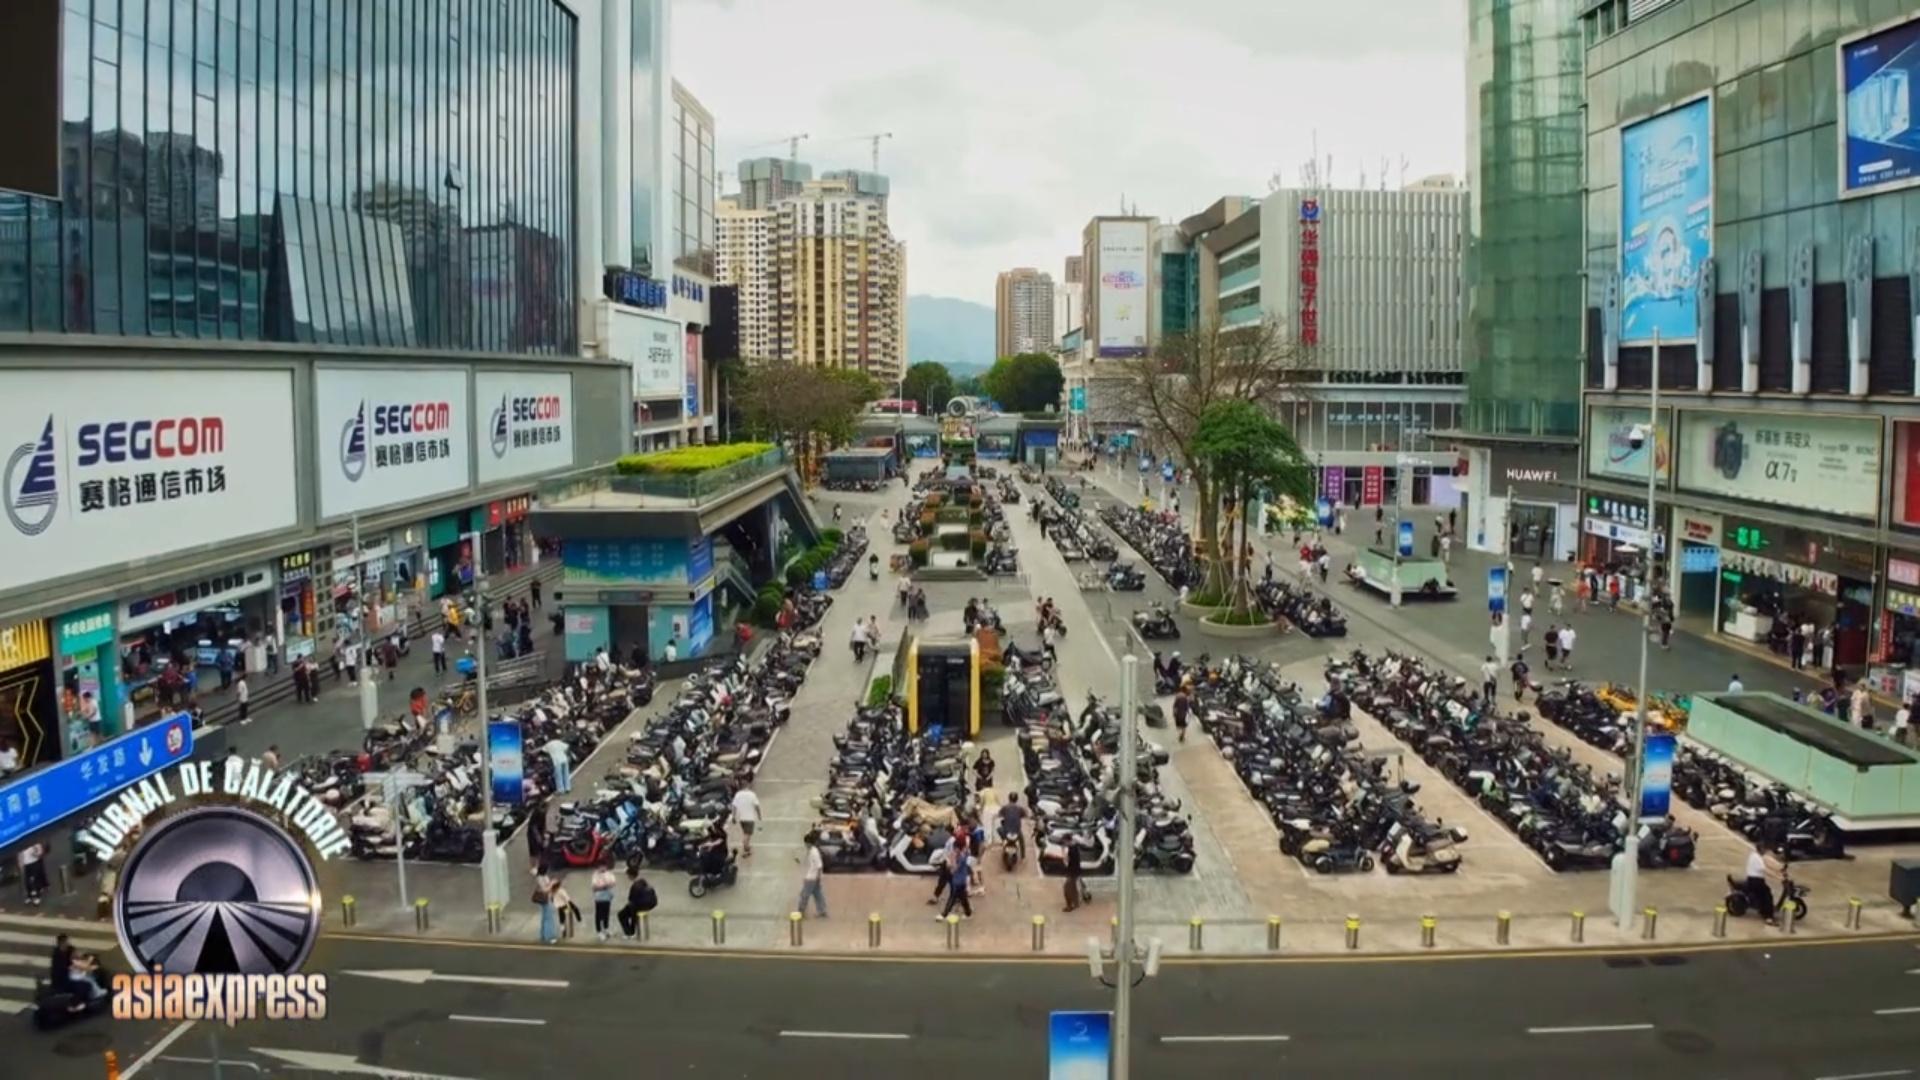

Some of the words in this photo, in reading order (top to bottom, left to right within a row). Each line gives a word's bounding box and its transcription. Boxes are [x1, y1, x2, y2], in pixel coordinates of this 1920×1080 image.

[1300, 229, 1318, 347] 华强电子世界
[374, 402, 450, 436] SEGCOM
[513, 396, 560, 421] SEGCOM
[78, 417, 223, 466] SEGCOM
[375, 438, 450, 468] 赛格通信市场
[513, 425, 561, 449] 赛格通信市场
[79, 465, 226, 513] 赛格通信市场
[1507, 468, 1557, 481] HUAWEI
